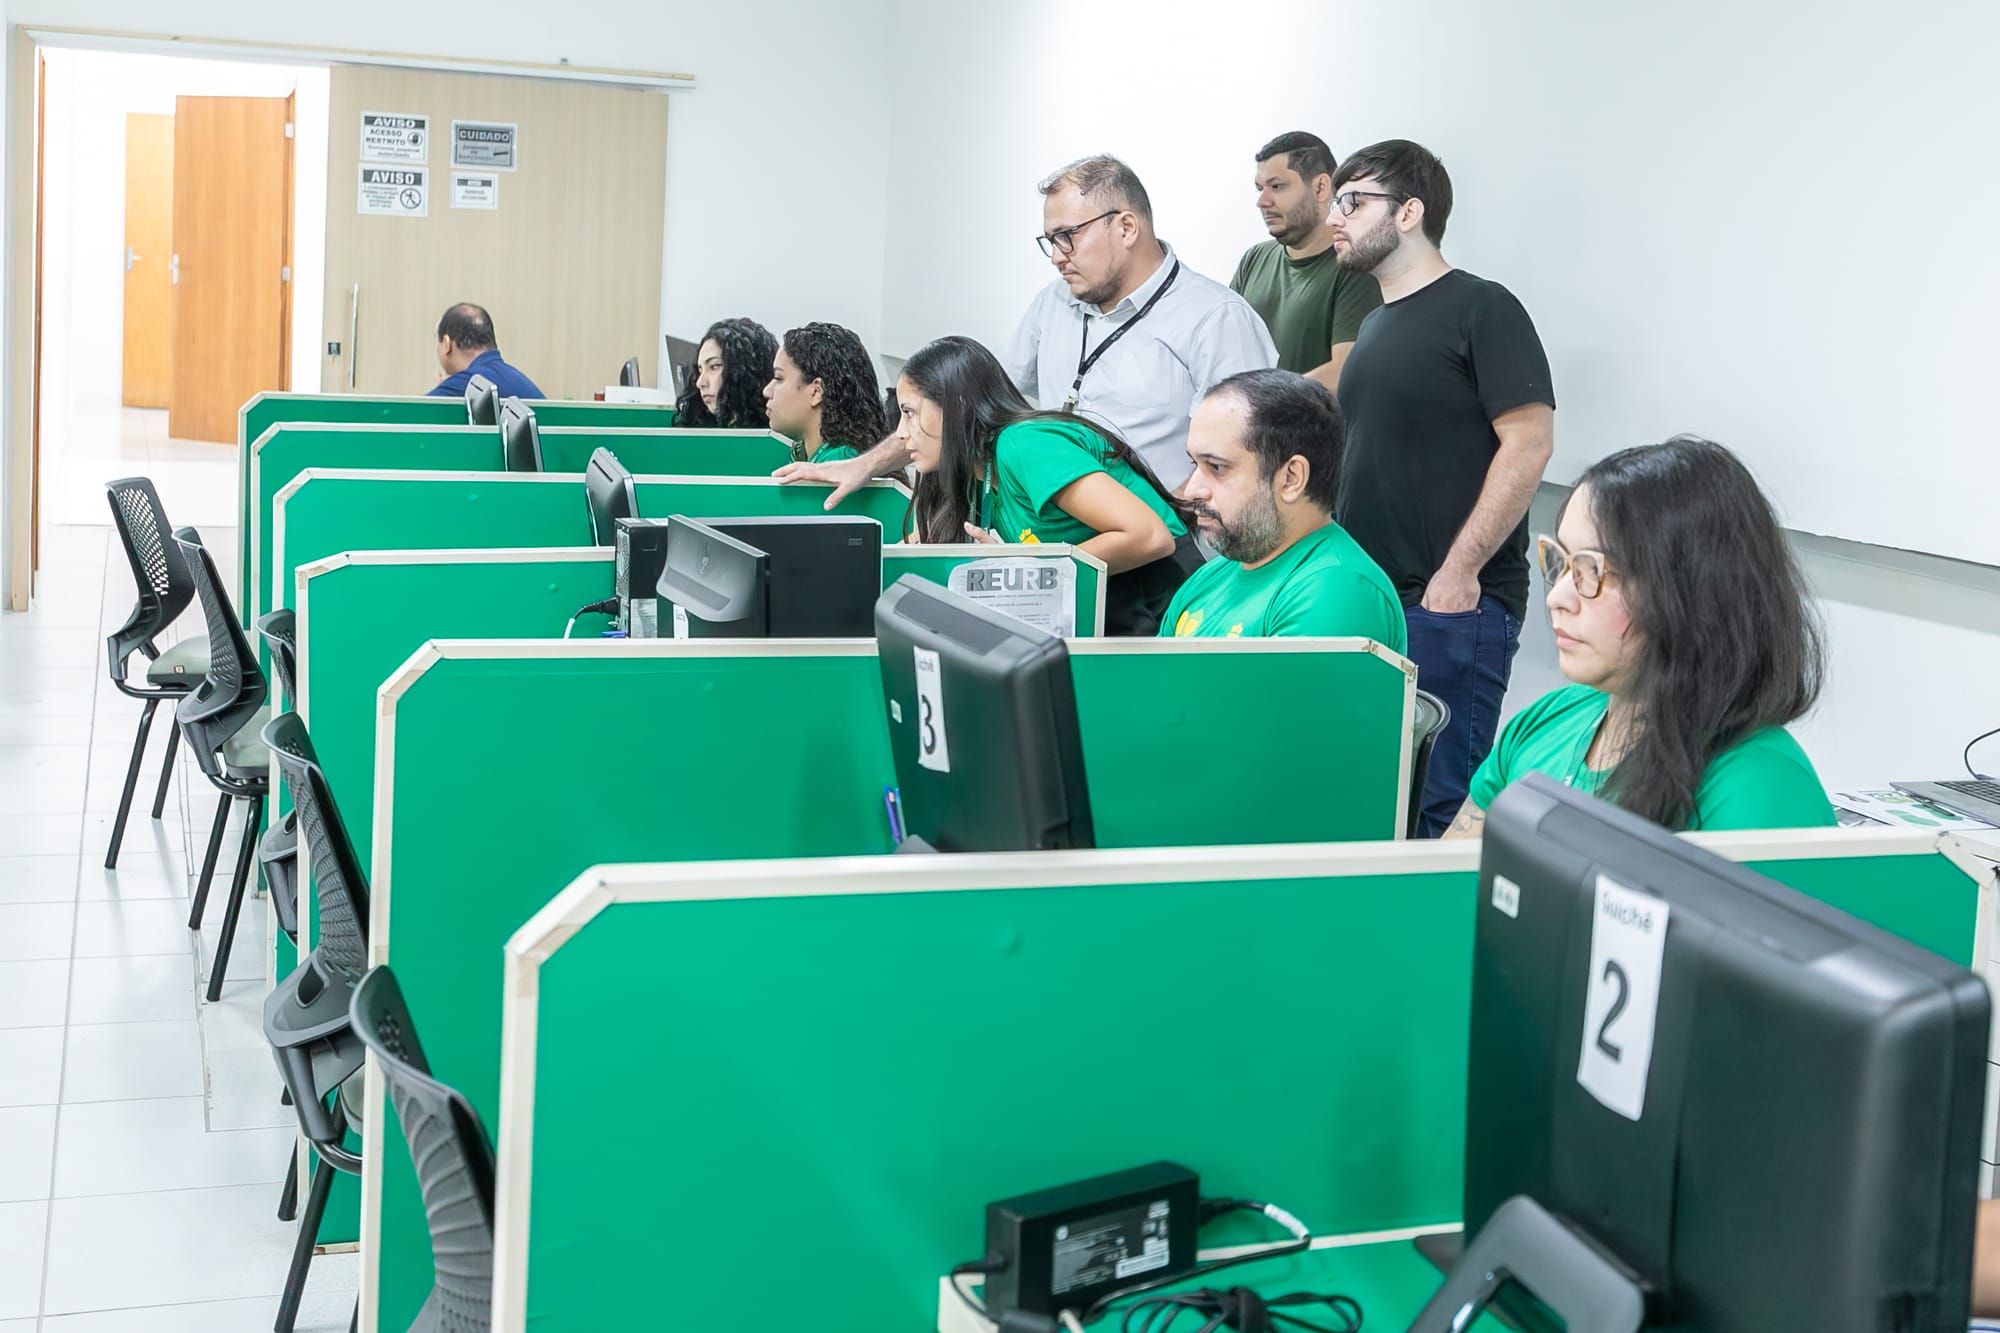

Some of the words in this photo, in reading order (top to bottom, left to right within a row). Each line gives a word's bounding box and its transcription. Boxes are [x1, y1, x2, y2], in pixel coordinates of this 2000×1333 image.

[373, 117, 416, 128] AVISO
[369, 128, 402, 137] ACESSO
[459, 129, 510, 142] CUIDADO
[365, 137, 406, 146] RESTRITO
[371, 170, 415, 185] AVISO
[966, 567, 1058, 592] REURB
[921, 694, 937, 756] 3
[1596, 959, 1630, 1063] 2
